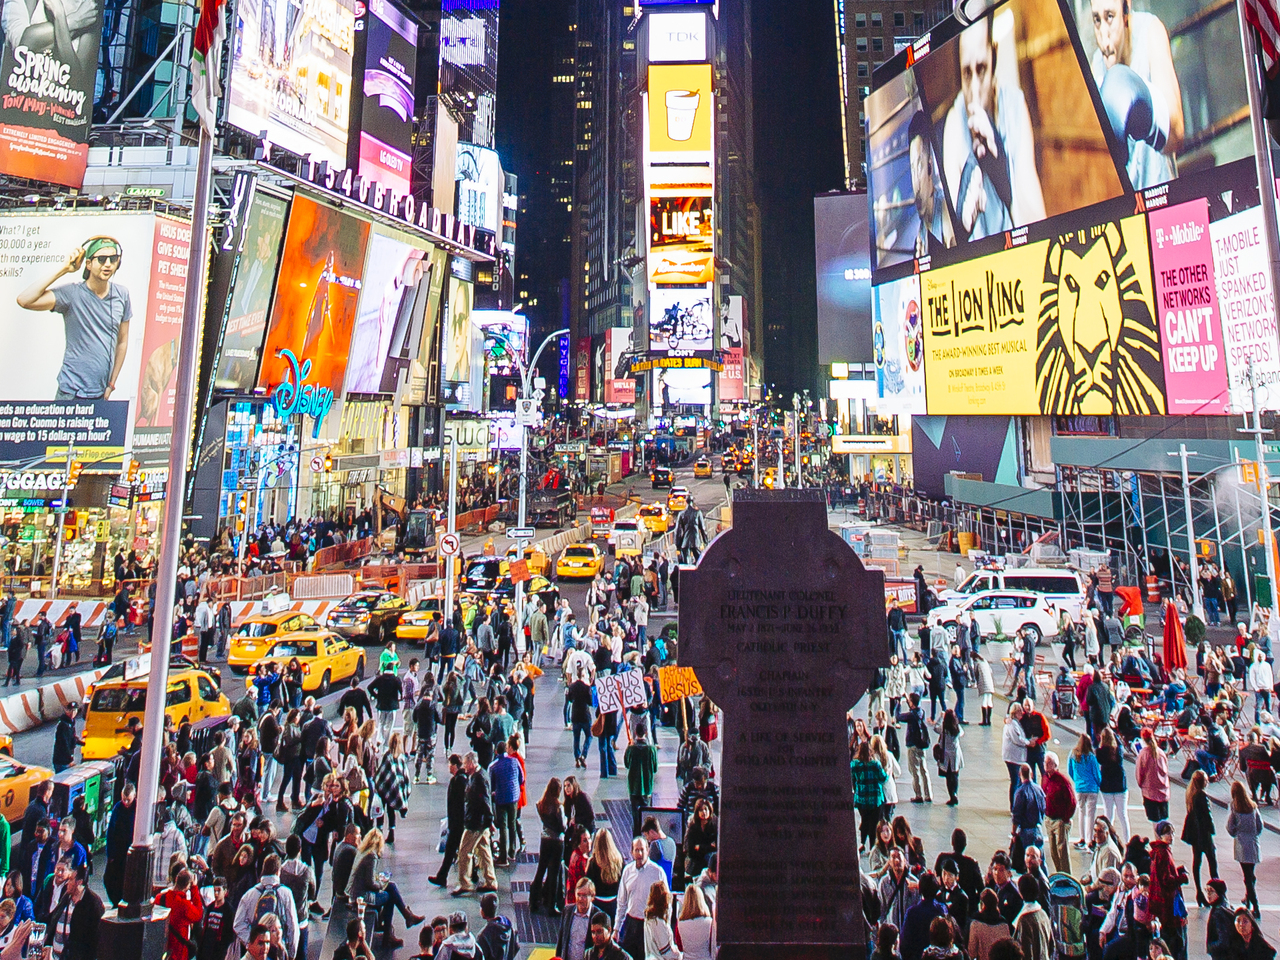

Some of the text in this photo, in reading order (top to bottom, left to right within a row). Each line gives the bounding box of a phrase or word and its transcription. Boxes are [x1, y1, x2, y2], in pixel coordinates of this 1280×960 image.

[665, 31, 699, 41] TDK
[13, 45, 71, 83] SPRING
[127, 188, 164, 196] LAMAR
[373, 183, 476, 248] BROADWAY
[661, 211, 701, 235] LIKE
[26, 226, 40, 238] get
[160, 223, 177, 240] HSUS
[33, 240, 51, 251] year
[157, 241, 172, 257] GIVE
[1215, 226, 1261, 257] T-MOBILE
[21, 254, 65, 266] experience
[157, 260, 171, 275] PET
[1219, 256, 1240, 280] JUST
[1160, 263, 1209, 289] THE OTHER
[1221, 271, 1267, 300] SPANKED
[928, 270, 1024, 338] THE LION KING
[1162, 285, 1212, 310] NETWORKS
[1224, 292, 1275, 321] VERIZON'S
[1165, 306, 1213, 346] CAN'T
[1227, 316, 1278, 344] NETWORK
[668, 349, 695, 357] SONY
[932, 339, 1027, 361] THE AWARD-WINNING BEST MUSICAL
[1167, 344, 1218, 373] KEEP UP
[1230, 342, 1273, 367] SPEEDS!
[728, 370, 743, 379] U.S.
[955, 367, 974, 378] BROADWAY
[978, 366, 989, 376] TIMES
[993, 365, 1004, 375] WEEK
[14, 406, 24, 415] an
[25, 404, 65, 415] education
[65, 405, 74, 415] or
[75, 404, 94, 415] hard
[11, 417, 29, 428] Gov.
[29, 417, 57, 428] Cuomo
[66, 417, 94, 430] raising
[95, 417, 109, 428] the
[3, 432, 26, 443] wage
[26, 431, 35, 441] to
[36, 430, 48, 441] 15
[48, 430, 76, 441] dollars
[76, 432, 87, 441] an
[87, 430, 111, 441] hour?
[720, 604, 778, 619] FRANCIS
[797, 604, 848, 620] DUFFY
